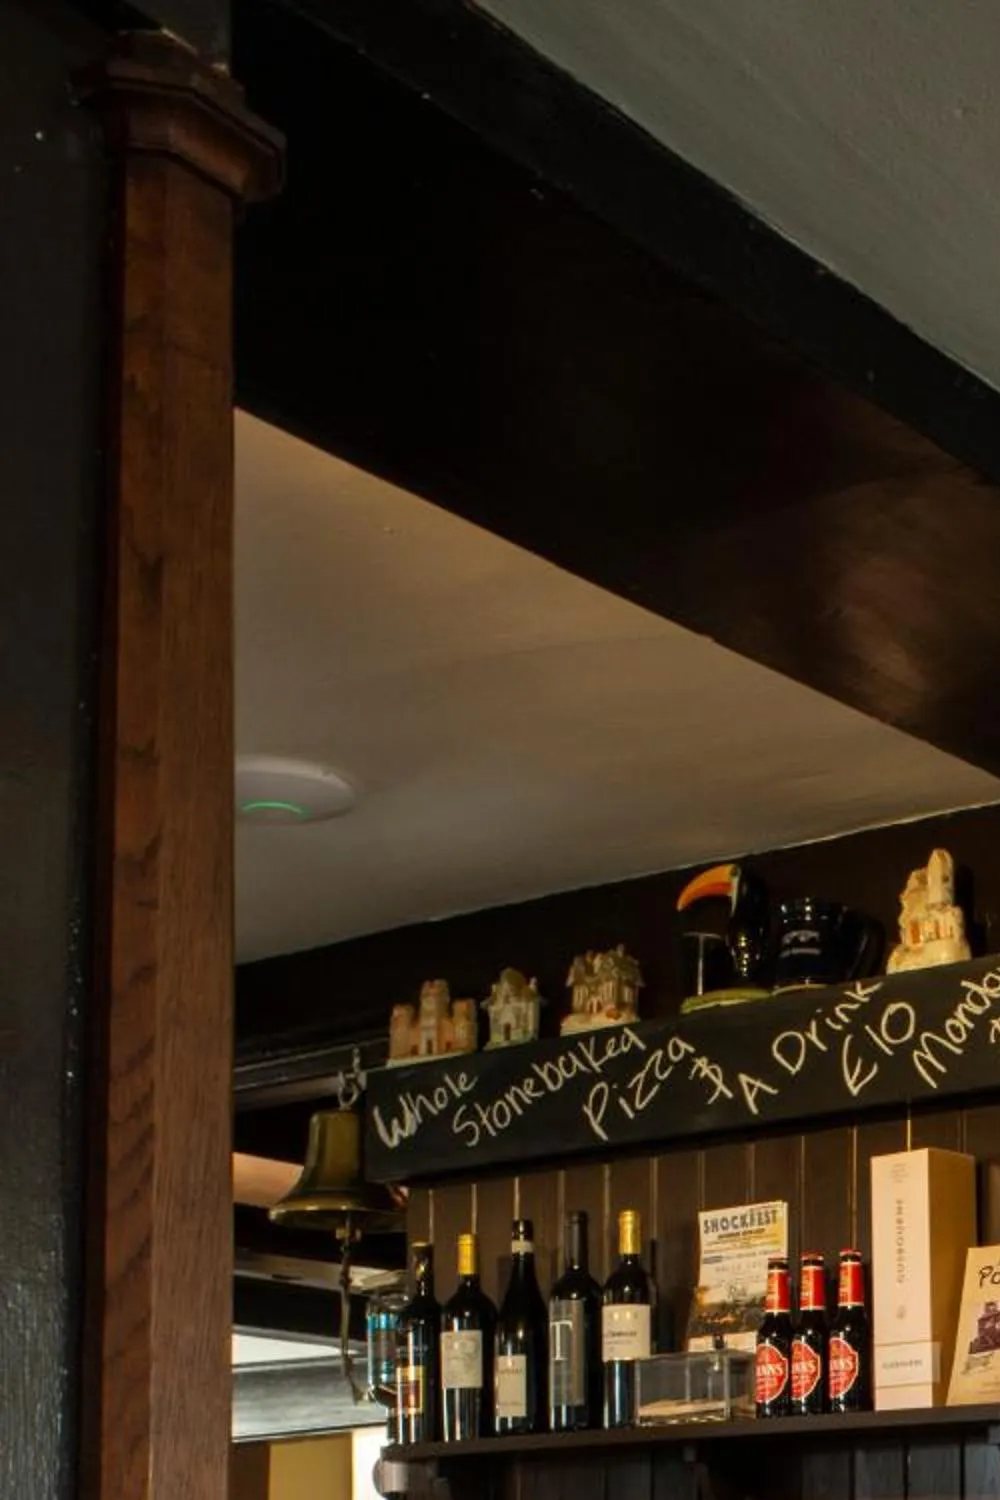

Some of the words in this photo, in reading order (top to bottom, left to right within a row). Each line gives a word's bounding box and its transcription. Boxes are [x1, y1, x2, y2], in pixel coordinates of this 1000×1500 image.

[372, 1070, 480, 1149] Whole
[451, 1026, 648, 1148] Stonebaked
[582, 1034, 696, 1142] Pizza
[737, 1072, 780, 1116] A
[771, 980, 884, 1077] Drink
